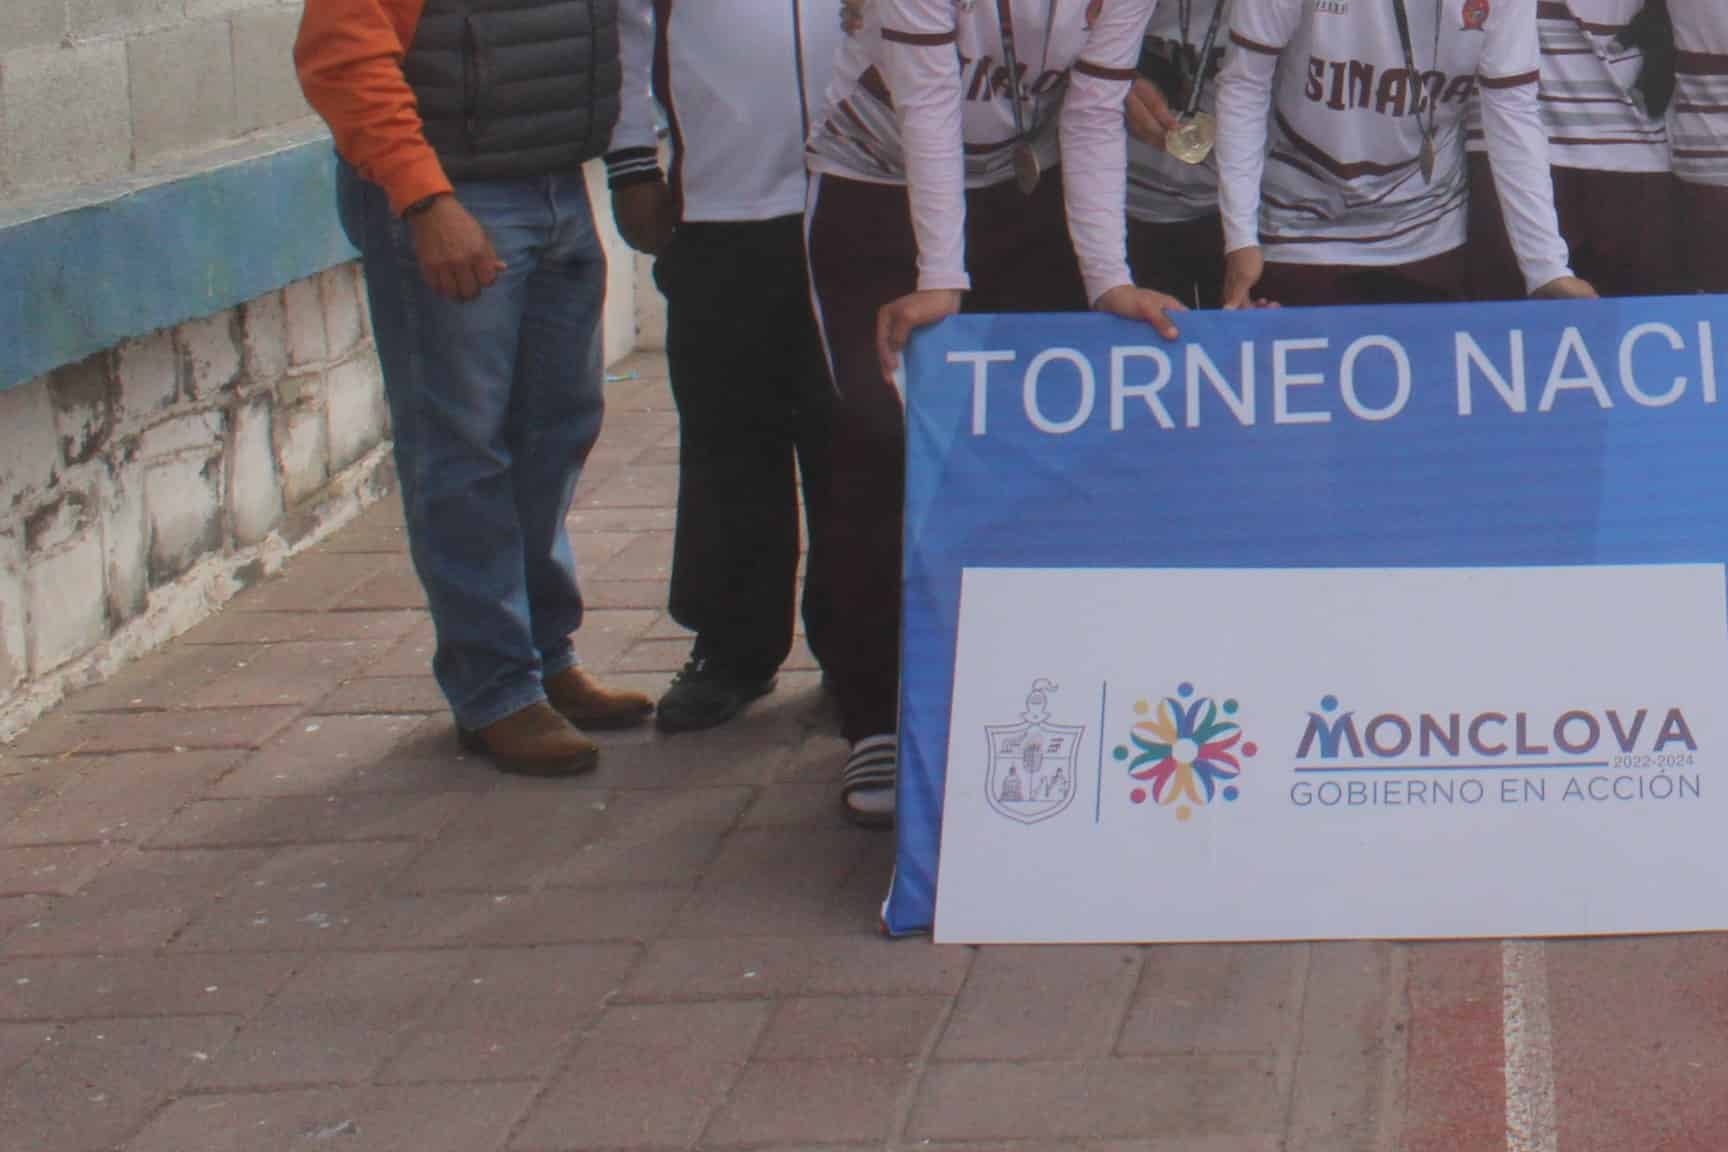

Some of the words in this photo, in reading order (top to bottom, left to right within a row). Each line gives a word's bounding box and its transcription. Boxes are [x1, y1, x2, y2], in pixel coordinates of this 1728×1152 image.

[945, 334, 1411, 436] TORNEO
[1295, 705, 1699, 760] MONCLOVA
[1612, 753, 1696, 769] 2022-2024
[1289, 778, 1485, 807] GOBIERNO
[1500, 776, 1546, 803] EN
[1561, 769, 1702, 802] ACCIÓN
